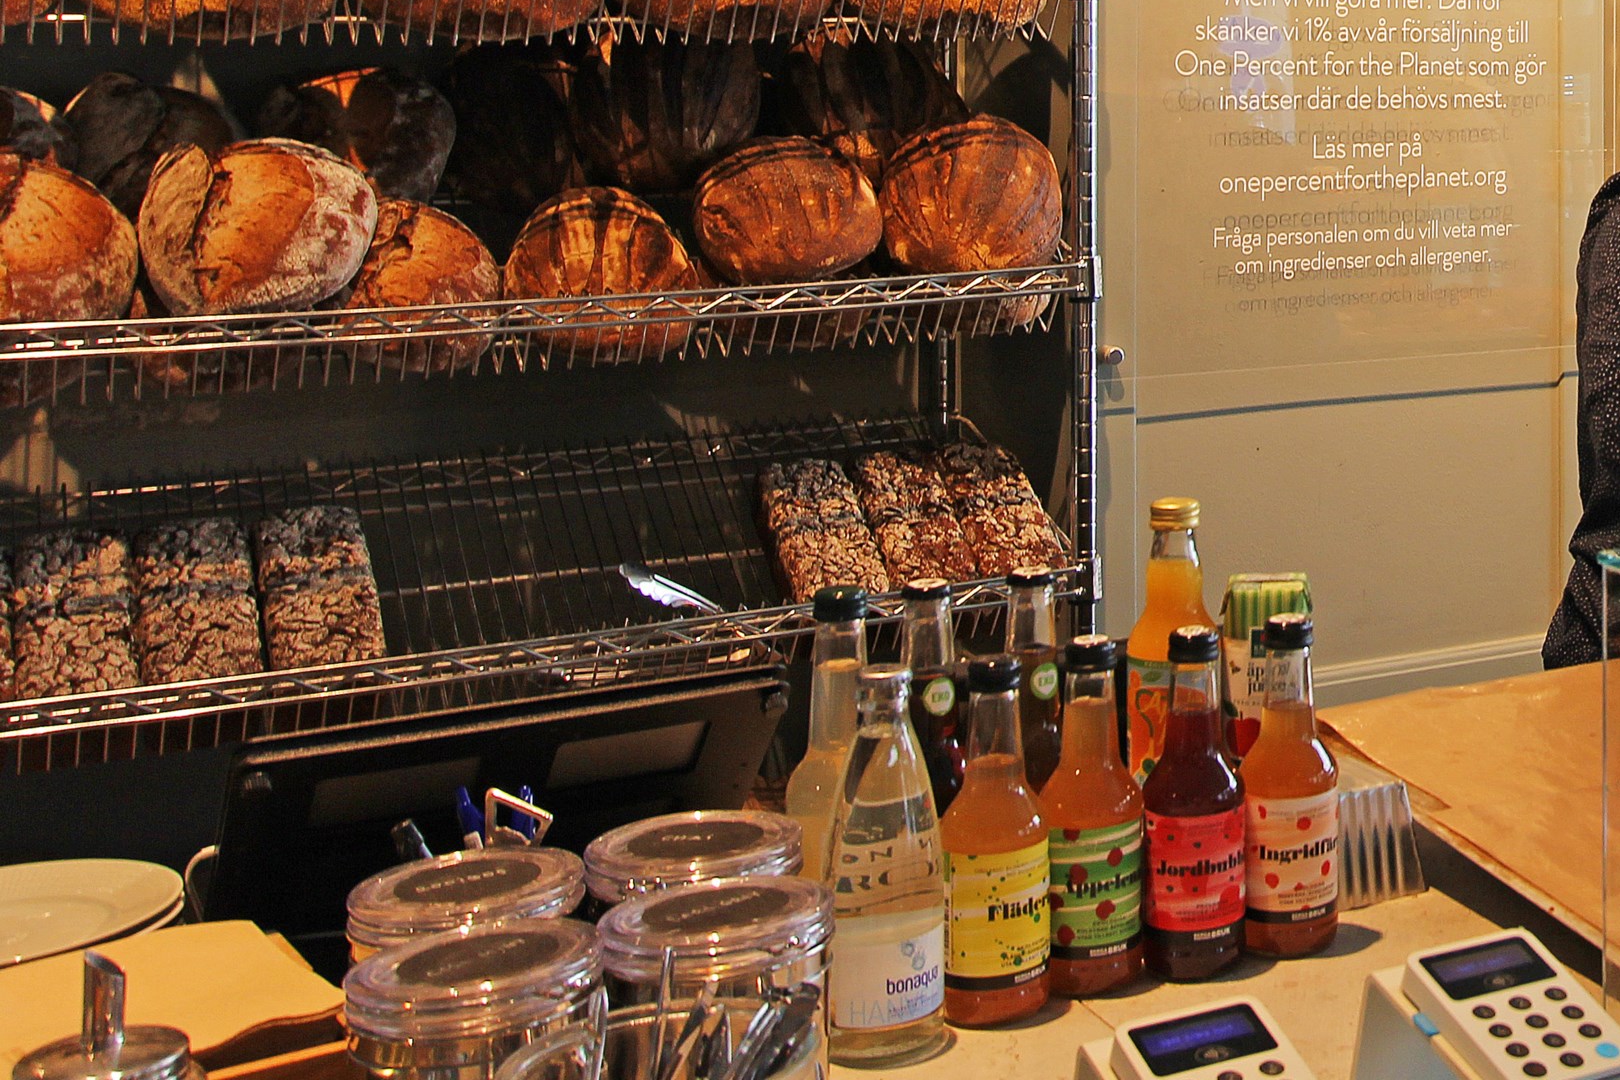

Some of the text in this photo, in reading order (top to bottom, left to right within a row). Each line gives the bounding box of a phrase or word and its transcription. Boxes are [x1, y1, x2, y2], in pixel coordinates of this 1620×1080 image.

[1194, 16, 1529, 52] skänker vi 1% av vår försäljning till
[1174, 49, 1546, 84] One Percent for the Planet som gör
[1219, 85, 1507, 111] insatser där de behövs mest.
[1312, 133, 1422, 167] Läs mer på
[1219, 164, 1507, 201] onepercentfortheplanet.org
[1213, 220, 1513, 255] Fråga personalen om du vill veta mer
[1234, 246, 1492, 280] om ingredienser och allergener.
[886, 964, 939, 996] bonaqua
